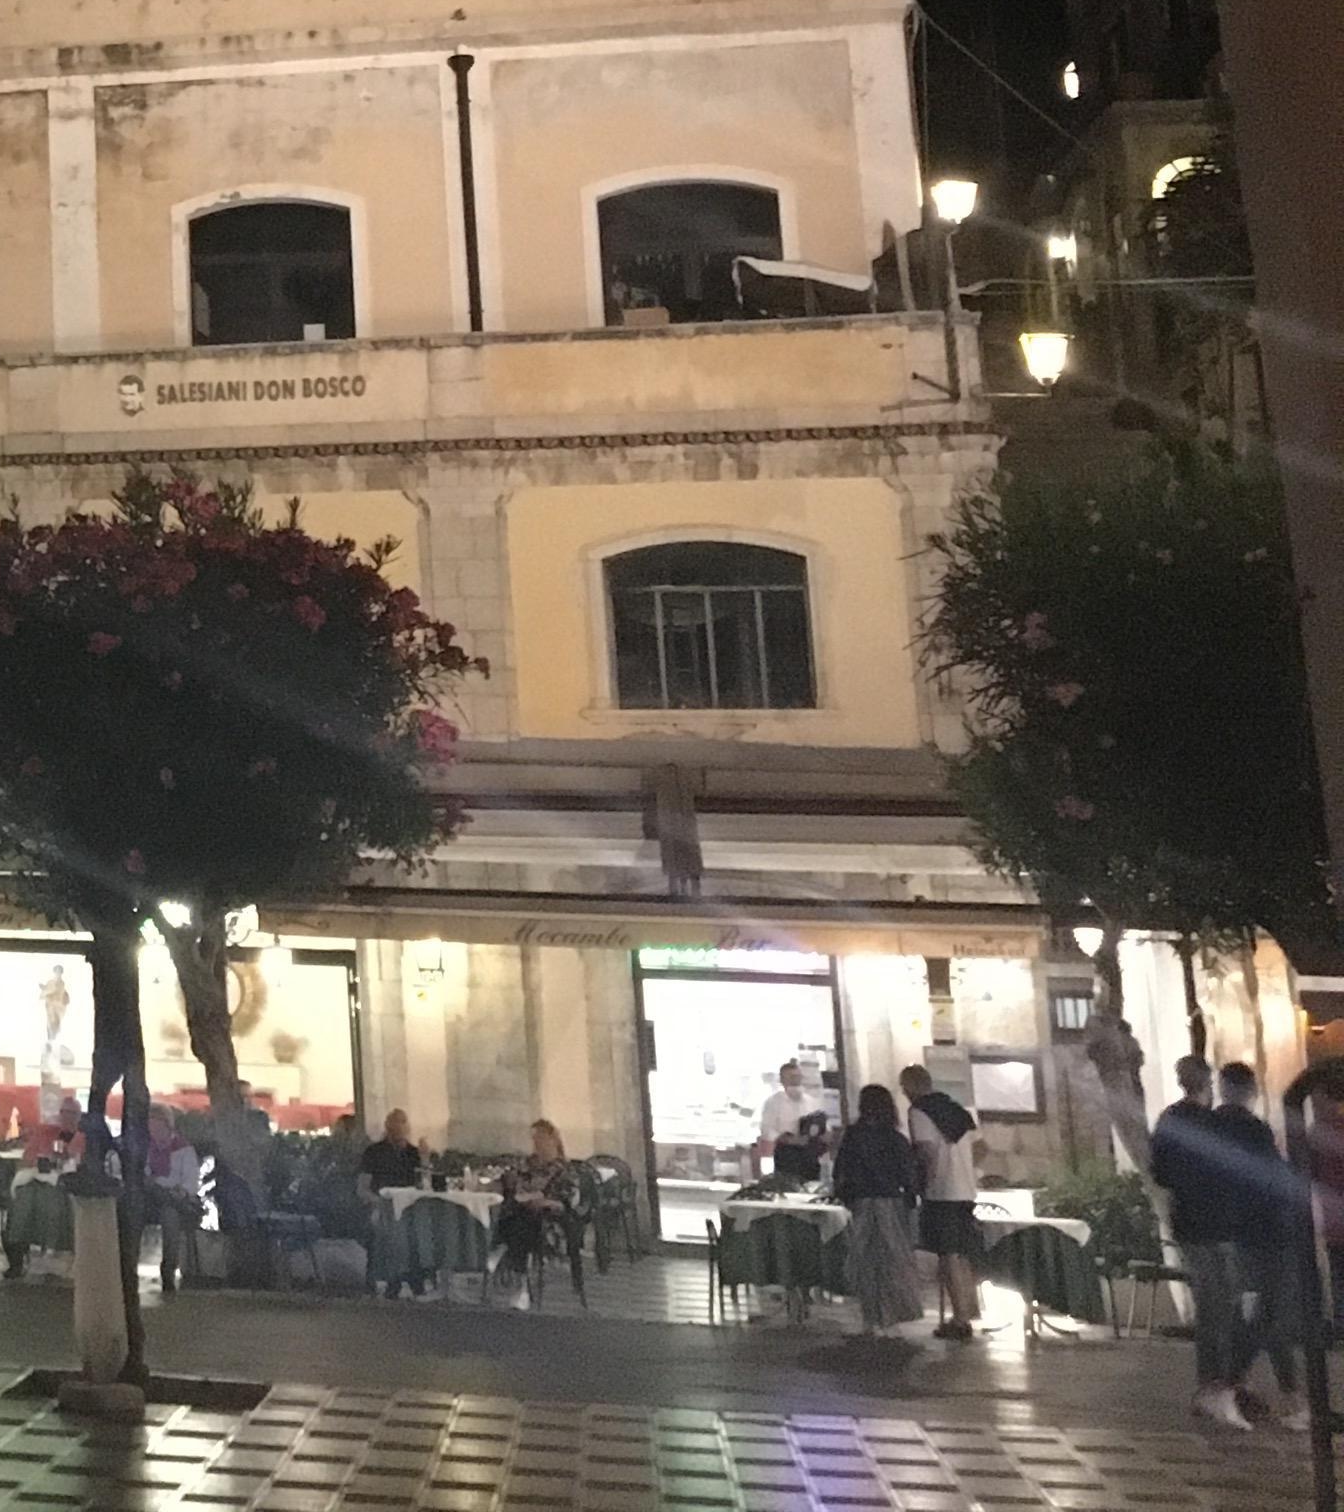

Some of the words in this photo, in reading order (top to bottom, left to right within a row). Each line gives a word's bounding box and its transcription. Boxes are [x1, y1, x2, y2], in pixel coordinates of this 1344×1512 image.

[156, 381, 247, 405] SALESIANI
[254, 379, 295, 402] DON
[301, 375, 367, 399] BOSCO
